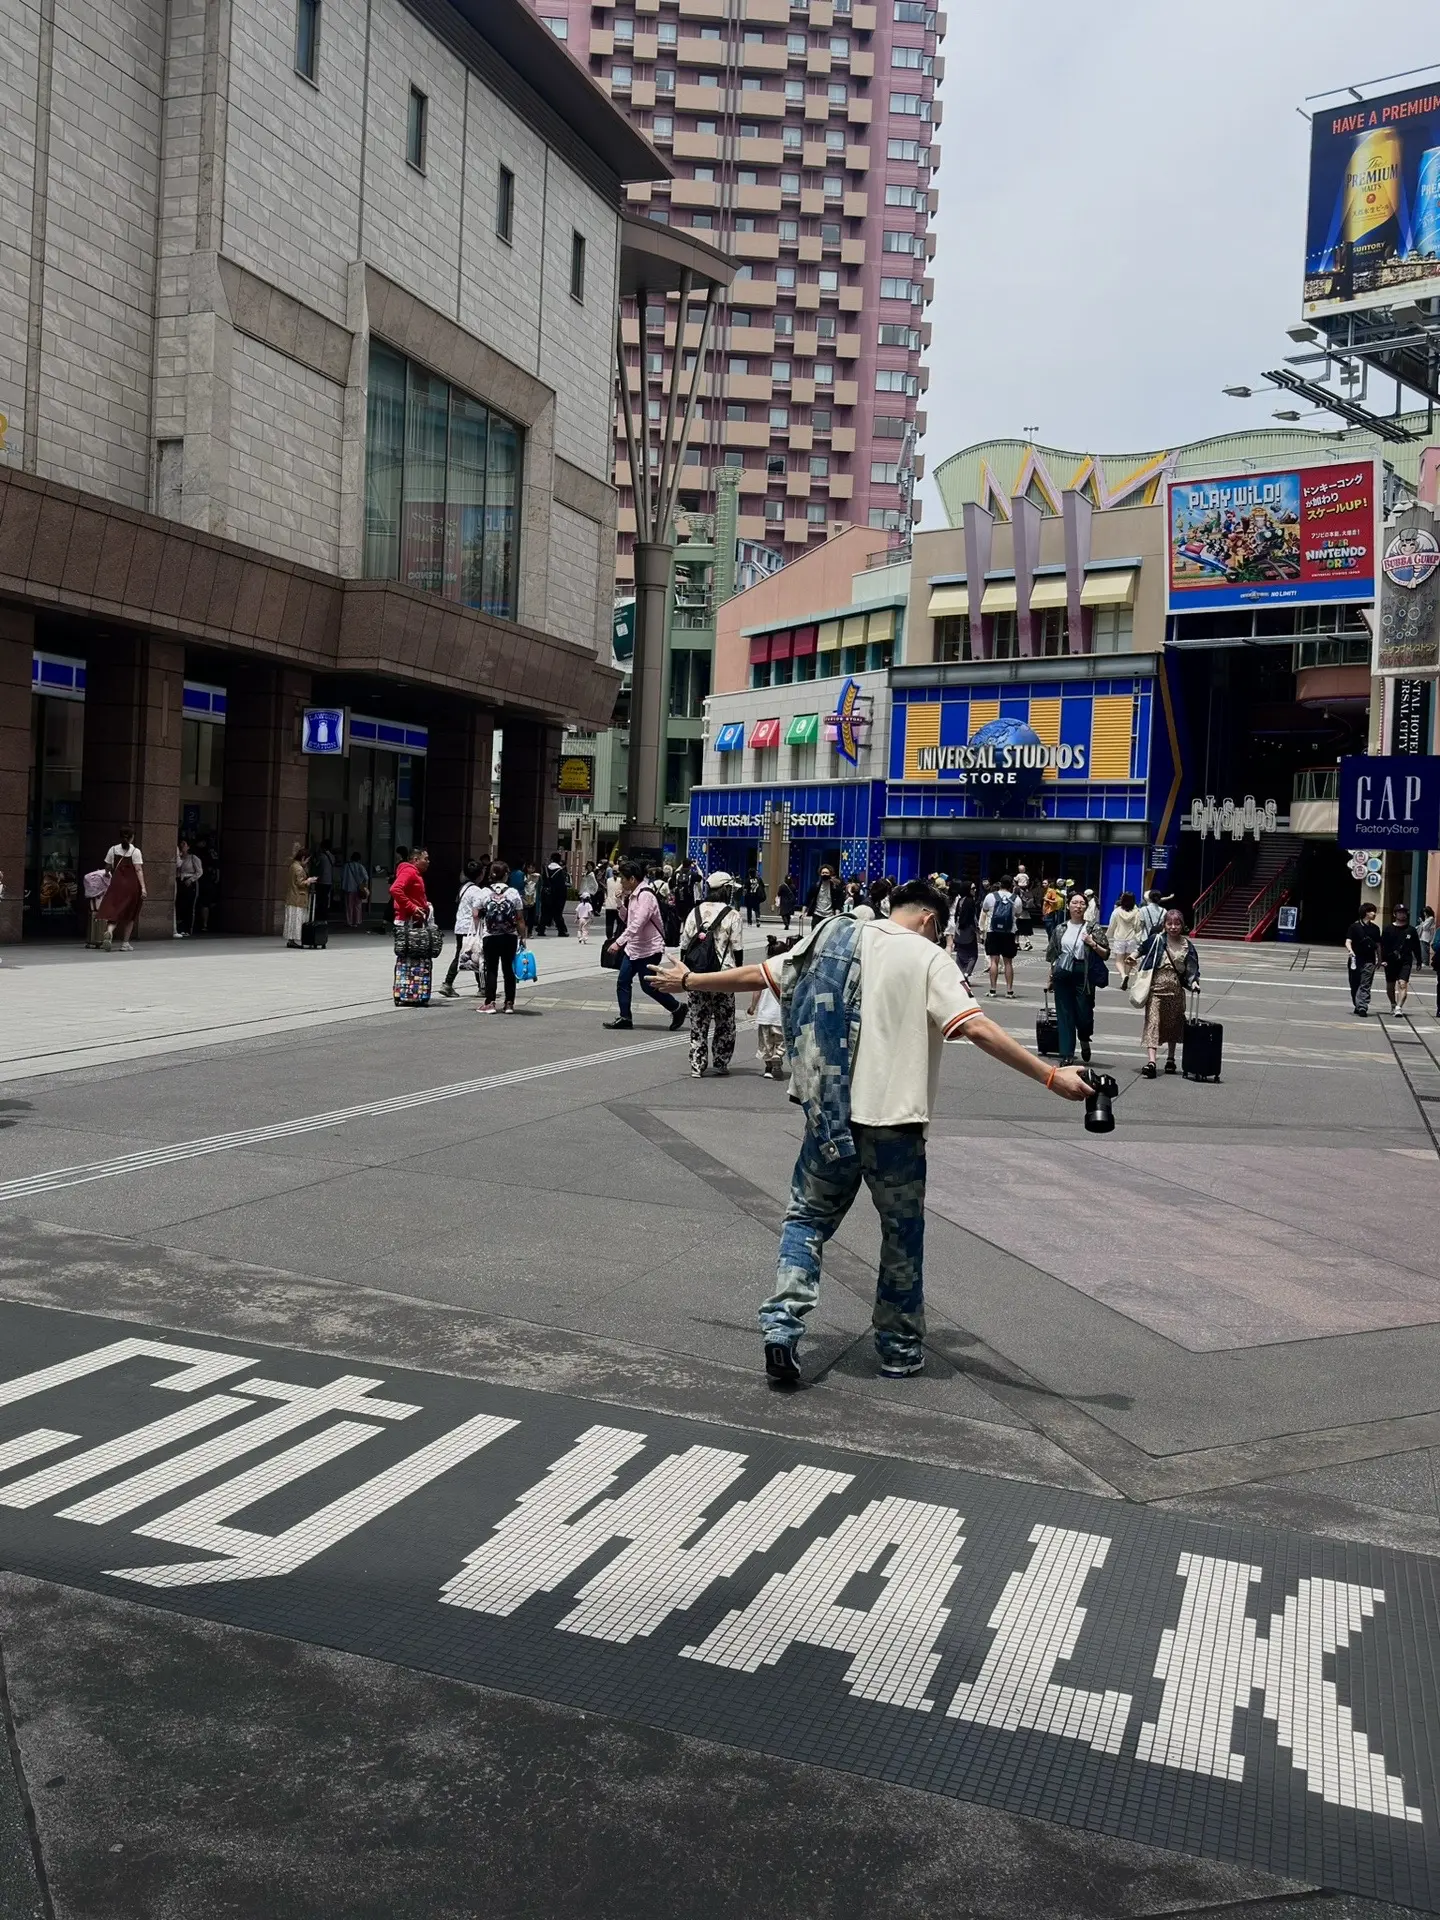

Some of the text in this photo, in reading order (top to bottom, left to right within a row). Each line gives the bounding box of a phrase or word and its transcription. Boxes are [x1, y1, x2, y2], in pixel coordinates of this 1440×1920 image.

[1332, 113, 1365, 135] HAVE
[1368, 110, 1378, 126] A
[1347, 163, 1399, 188] PREMIUM
[1352, 241, 1386, 254] SUNTORY
[1303, 473, 1363, 497] ドンキーコング
[1189, 488, 1231, 510] PLAY
[1305, 493, 1339, 508] が加わり
[1305, 546, 1367, 561] NINTENDO
[1384, 556, 1412, 570] BUBBA
[1414, 553, 1439, 564] GUMP
[307, 741, 337, 749] STATION
[1399, 720, 1409, 752] CITY
[917, 743, 1085, 770] UNIVERSAL STUDIOS
[958, 772, 1017, 784] STORE
[1356, 775, 1421, 820] GAP
[700, 814, 752, 827] UNIVERSAL
[798, 812, 835, 826] STORE
[438, 1424, 1423, 1824] WALK
